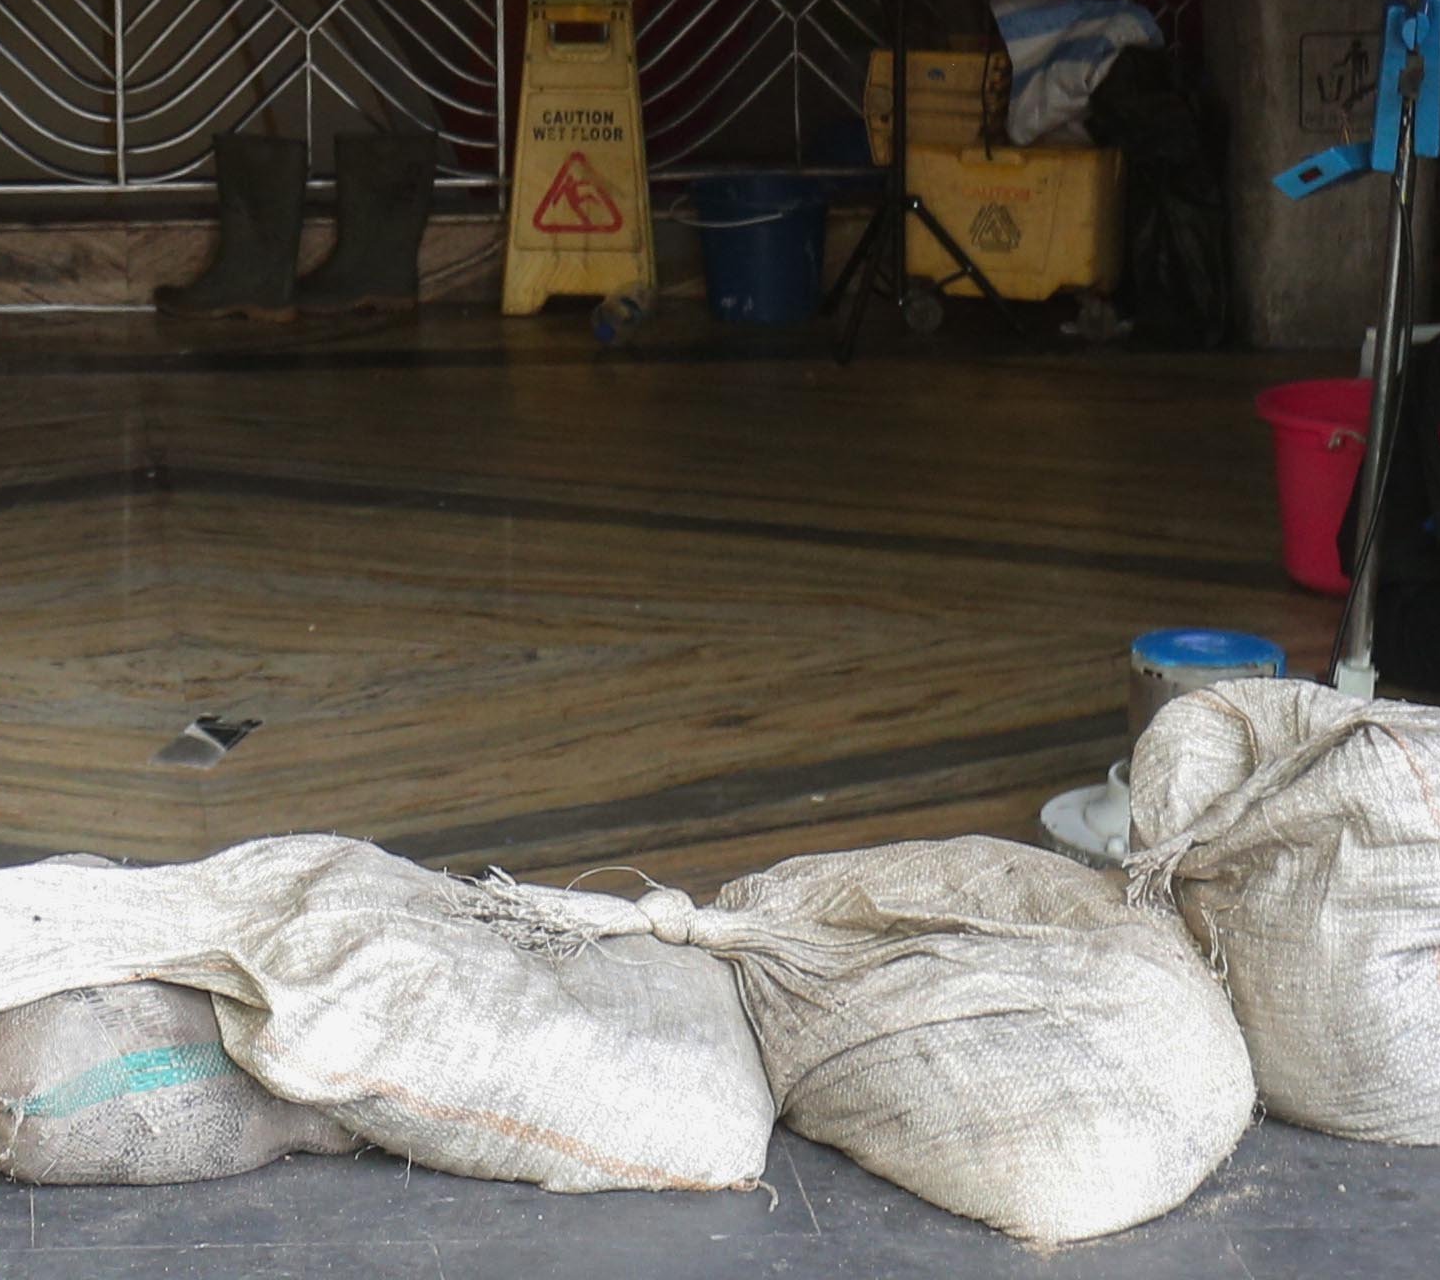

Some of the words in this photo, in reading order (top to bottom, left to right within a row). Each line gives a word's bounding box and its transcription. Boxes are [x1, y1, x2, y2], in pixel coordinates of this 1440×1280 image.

[542, 109, 615, 125] CAUTION
[532, 127, 566, 142] WET
[570, 126, 624, 142] FLOOR
